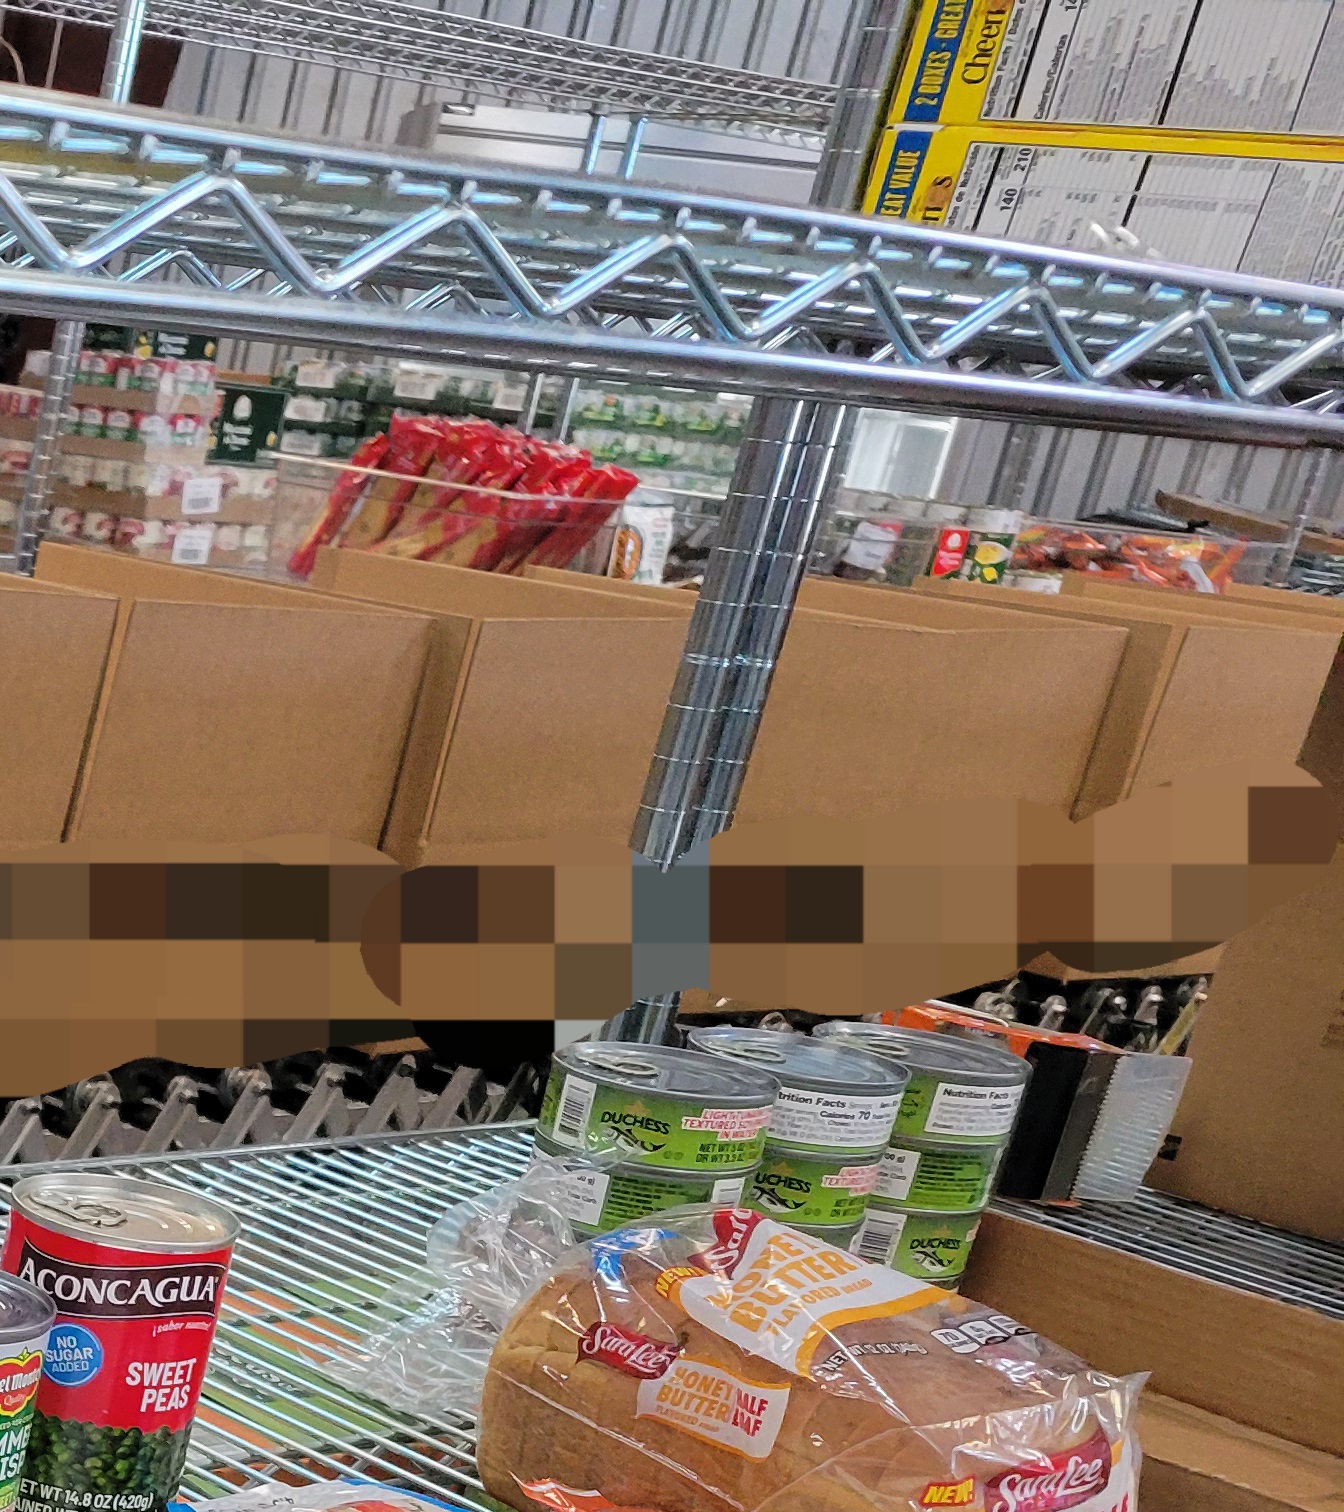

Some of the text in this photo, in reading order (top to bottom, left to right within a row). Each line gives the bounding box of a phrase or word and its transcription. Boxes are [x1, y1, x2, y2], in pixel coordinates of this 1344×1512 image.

[914, 51, 951, 106] 2 BOXES
[880, 150, 920, 216] EAT VALUE
[601, 1111, 670, 1135] DUCHESS
[18, 1257, 215, 1307] ACONCAGUA
[45, 1346, 94, 1361] SUGAR
[56, 1336, 77, 1349] NO
[52, 1360, 89, 1372] ADDED
[125, 1358, 197, 1386] SWEET
[140, 1385, 190, 1413] PEAS
[1055, 1454, 1103, 1496] Lee
[64, 1490, 154, 1511] 14.8 OZ (420g)
